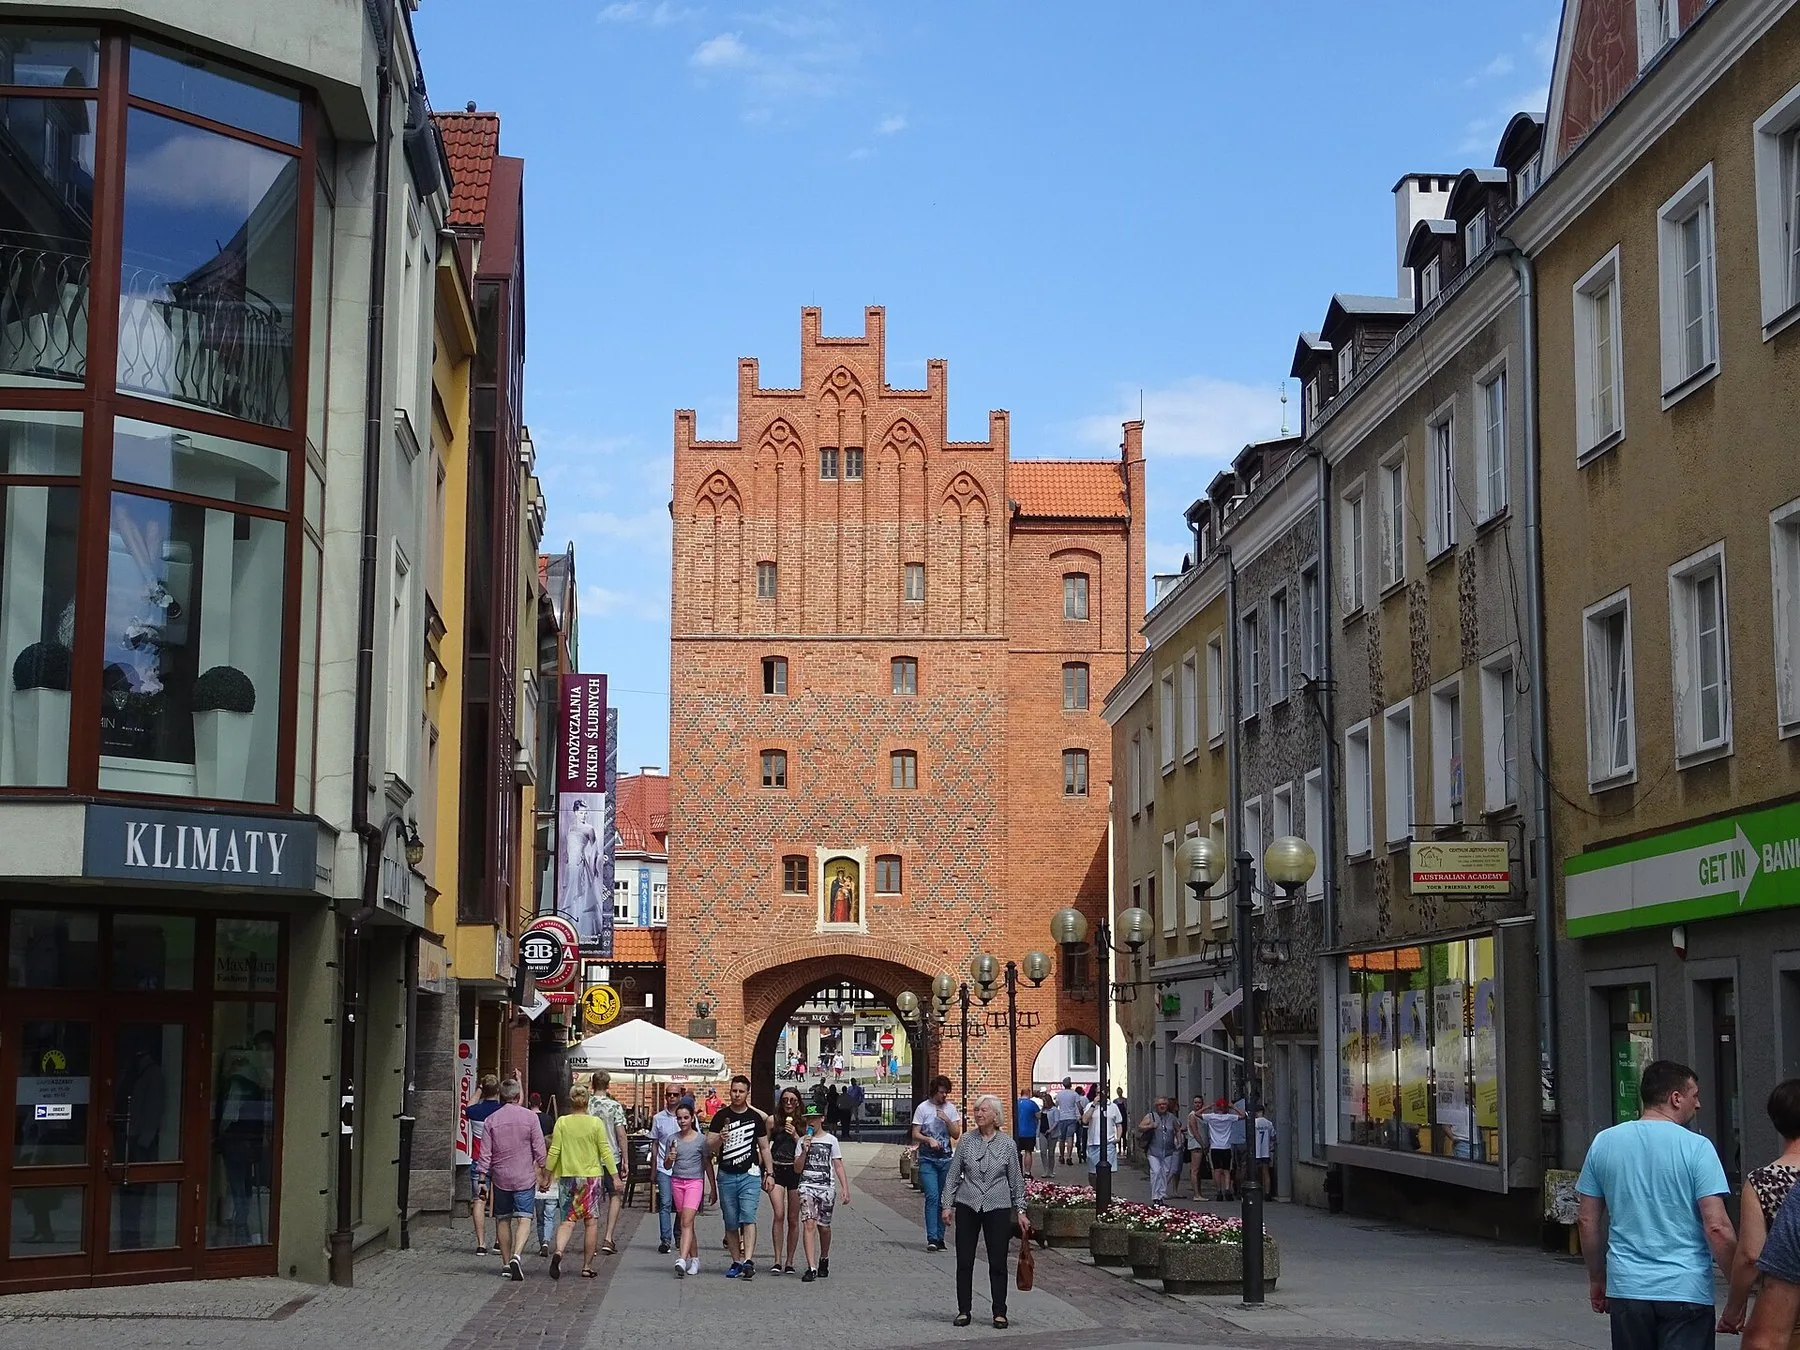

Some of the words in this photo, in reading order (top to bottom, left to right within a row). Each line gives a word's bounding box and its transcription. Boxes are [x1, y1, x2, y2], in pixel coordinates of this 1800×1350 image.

[585, 678, 600, 739] ŚLUBNYCH
[566, 686, 582, 780] WYPOŻYCZALNIA
[586, 744, 598, 788] SUKIEN
[124, 821, 288, 875] KLIMATY
[1699, 853, 1727, 886] GET
[1730, 848, 1746, 879] IN
[1419, 873, 1466, 881] AUSTRALIAN
[641, 882, 649, 925] MASTERS
[626, 1059, 649, 1067] TYSKIE
[683, 1057, 715, 1065] SPHINX
[1259, 1131, 1265, 1145] 7
